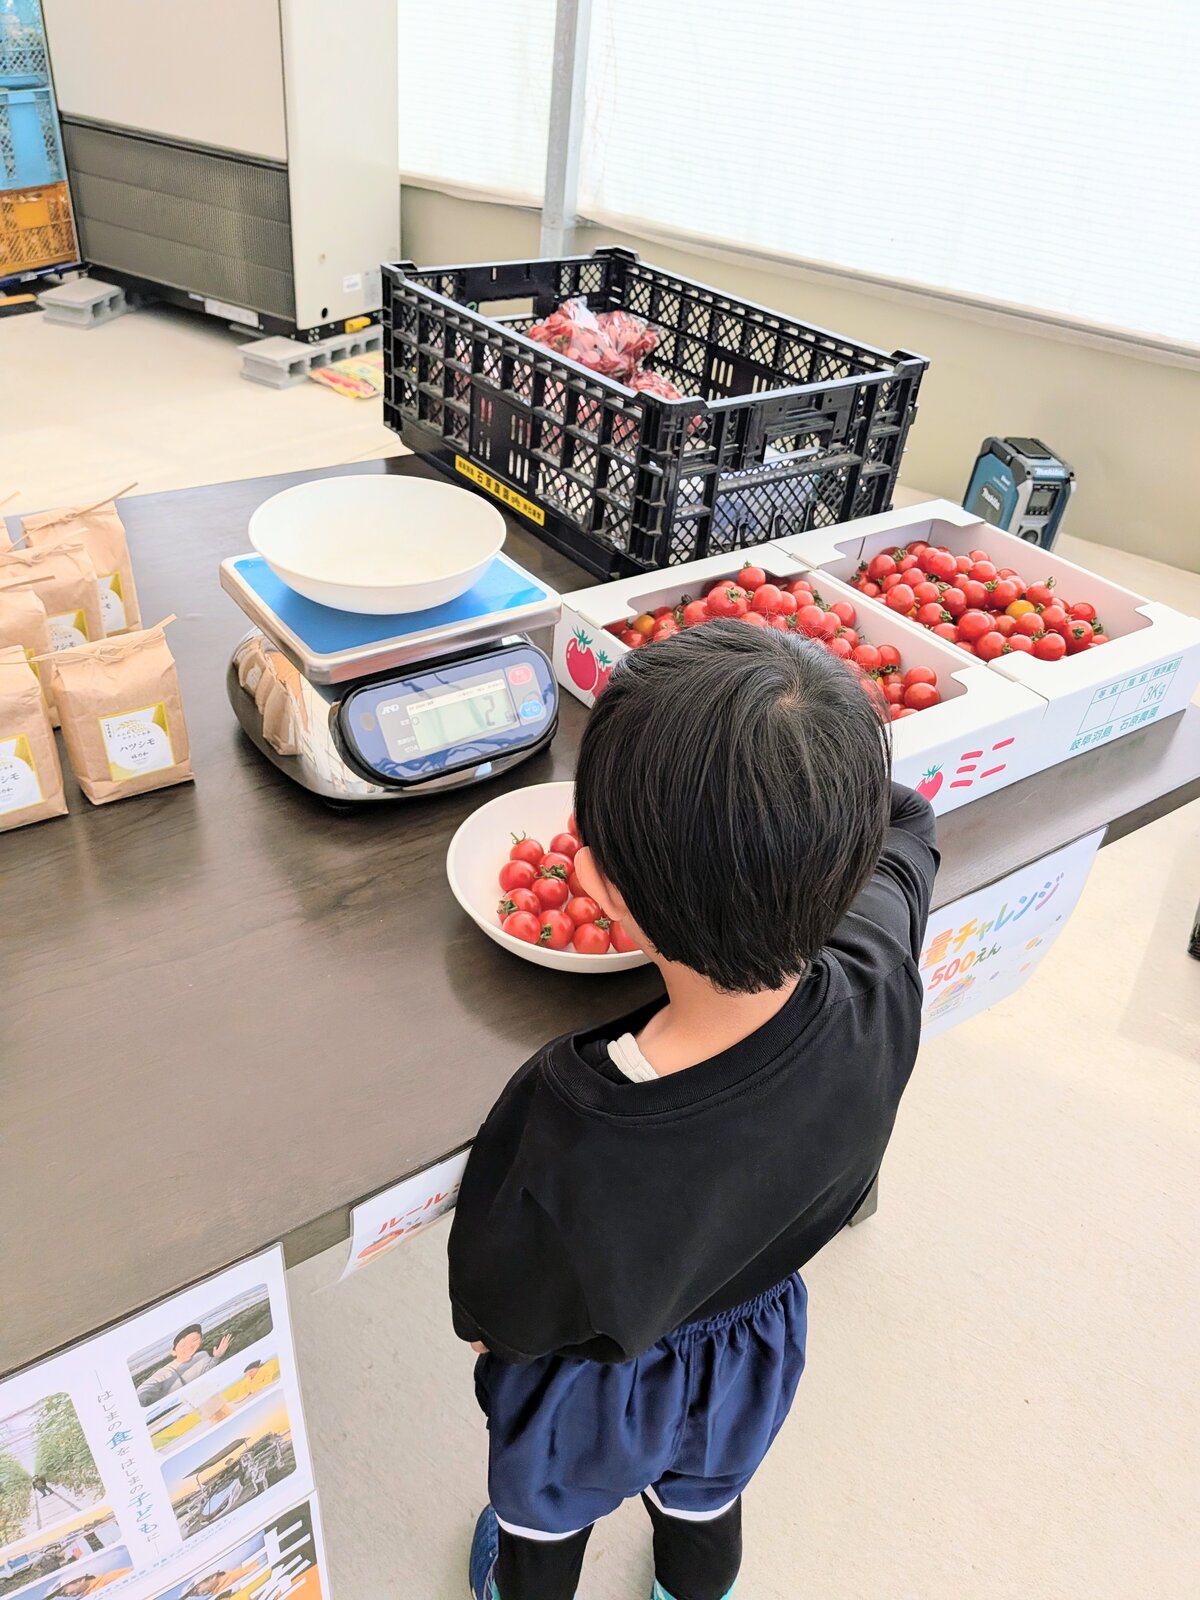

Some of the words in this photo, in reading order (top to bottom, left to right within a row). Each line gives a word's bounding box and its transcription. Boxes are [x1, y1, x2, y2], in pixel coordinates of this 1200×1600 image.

[950, 737, 1016, 789] ミニ
[919, 872, 1065, 972] 量チャレンジ
[928, 942, 1002, 991] 500えん
[378, 1184, 459, 1235] ルール
